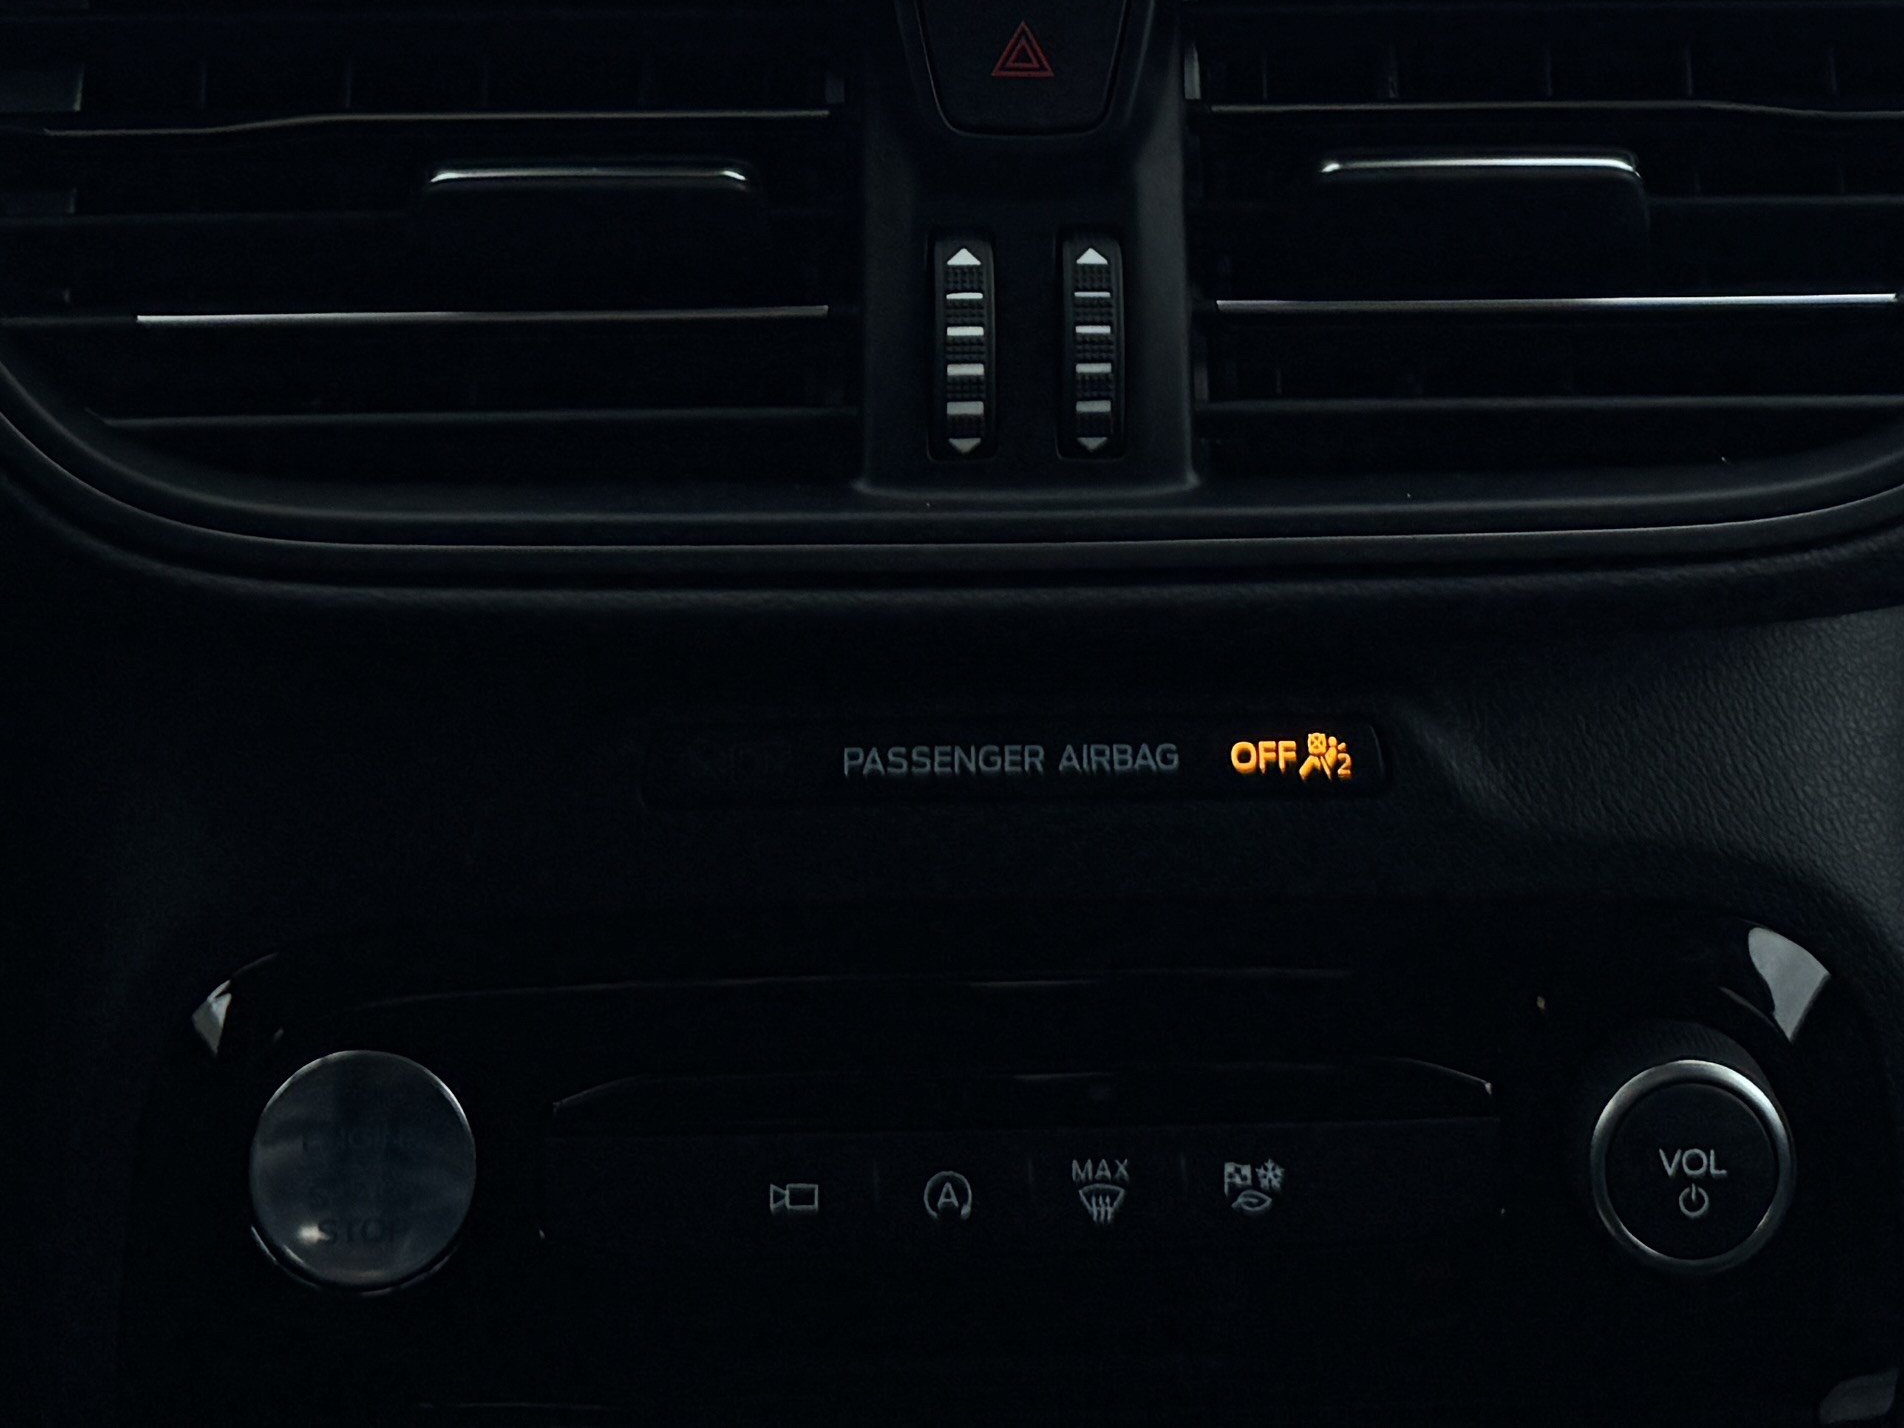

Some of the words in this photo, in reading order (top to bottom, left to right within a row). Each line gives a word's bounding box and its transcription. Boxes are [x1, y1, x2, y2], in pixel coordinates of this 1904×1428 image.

[843, 744, 1045, 777] PASSENGER
[1058, 743, 1179, 773] AIRBAG
[1230, 740, 1297, 776] OFF
[1071, 1158, 1130, 1182] MAX
[1659, 1148, 1727, 1178] VOL
